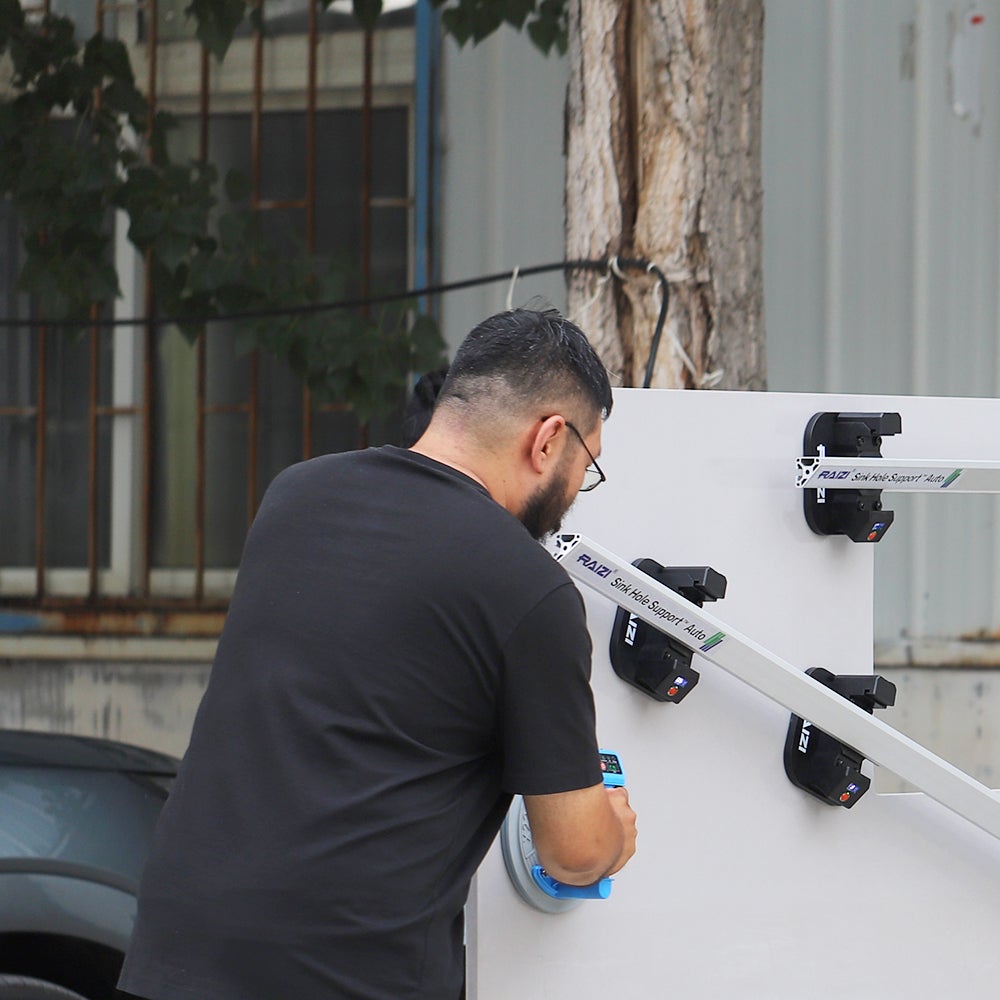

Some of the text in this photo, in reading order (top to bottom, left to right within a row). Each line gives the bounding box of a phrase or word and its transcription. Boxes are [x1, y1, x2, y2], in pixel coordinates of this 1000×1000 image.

[818, 470, 850, 480] RAIZI
[851, 472, 868, 482] Sink
[869, 473, 888, 483] Hole
[924, 473, 944, 483] Auto
[577, 554, 707, 641] RAIZI Sink Hole Support Auto
